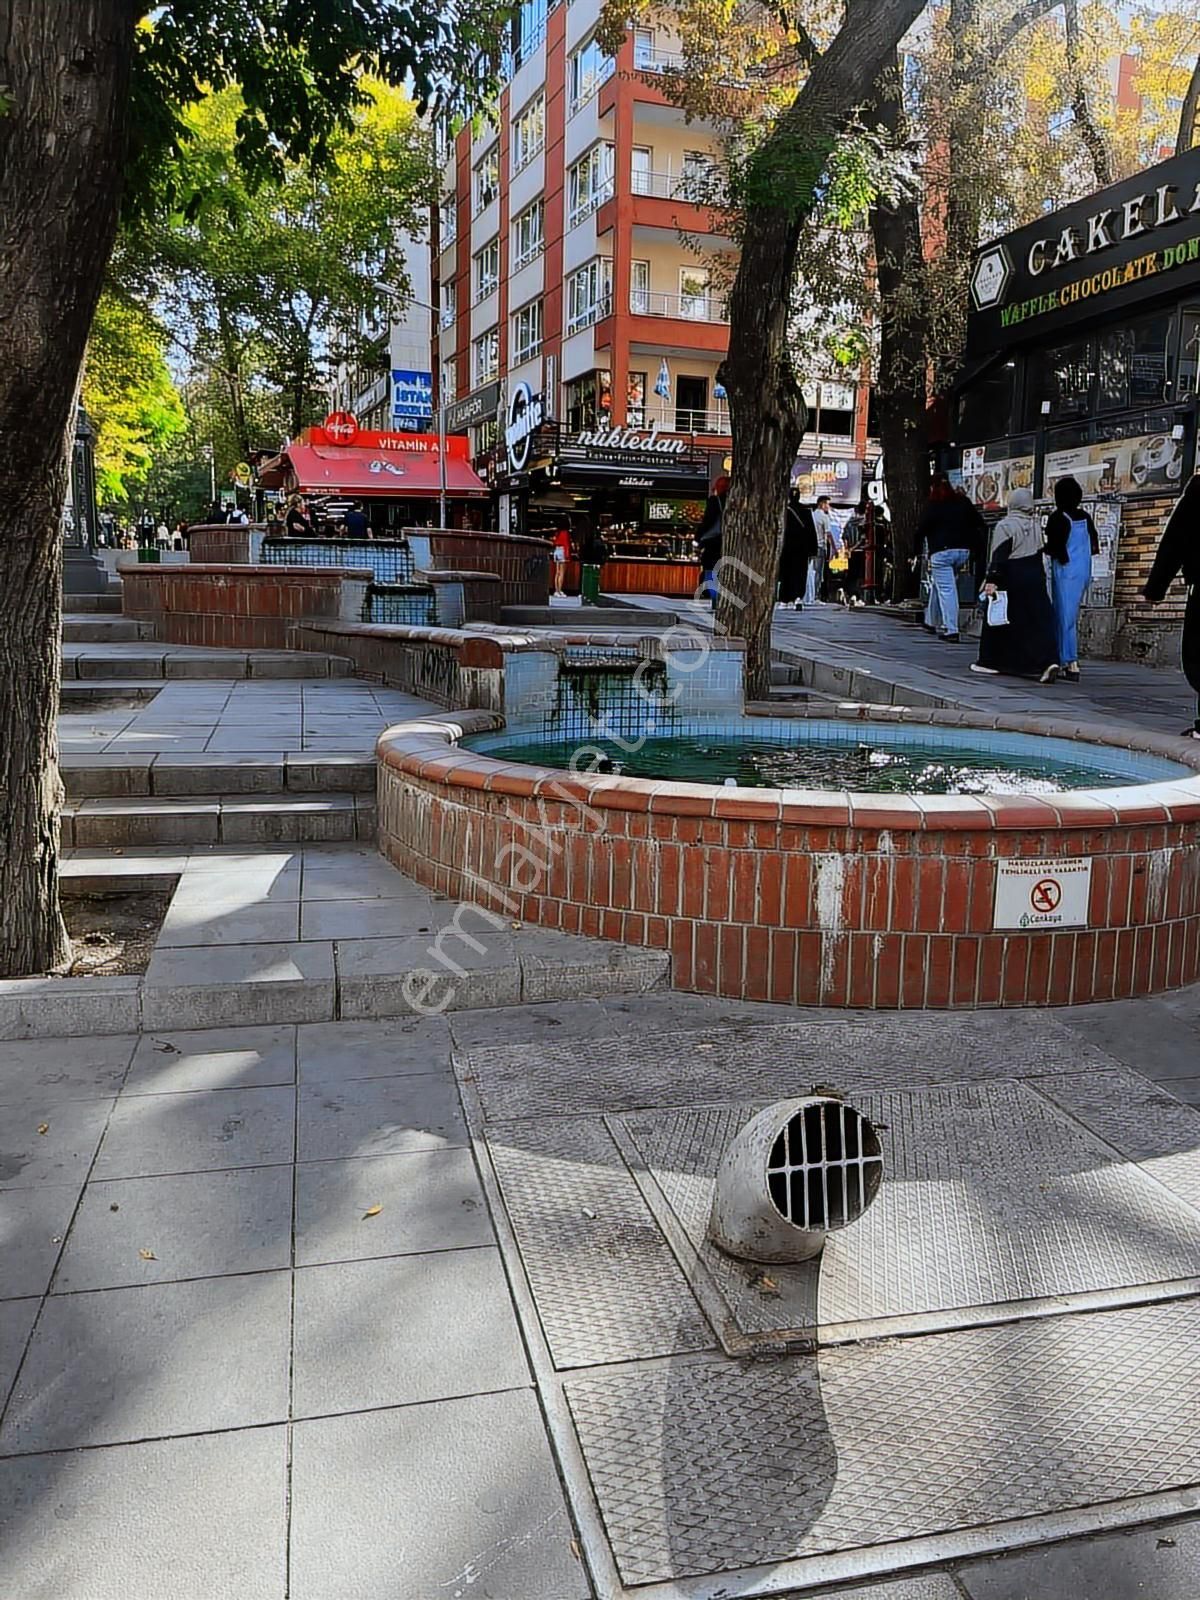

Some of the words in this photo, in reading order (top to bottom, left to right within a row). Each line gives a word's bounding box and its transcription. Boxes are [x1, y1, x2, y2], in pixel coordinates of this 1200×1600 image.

[1001, 289, 1059, 328] WAFFLE
[1060, 252, 1159, 307] CHOCOLATE
[378, 437, 428, 451] VİTAMİN
[577, 421, 688, 454] nüktedan
